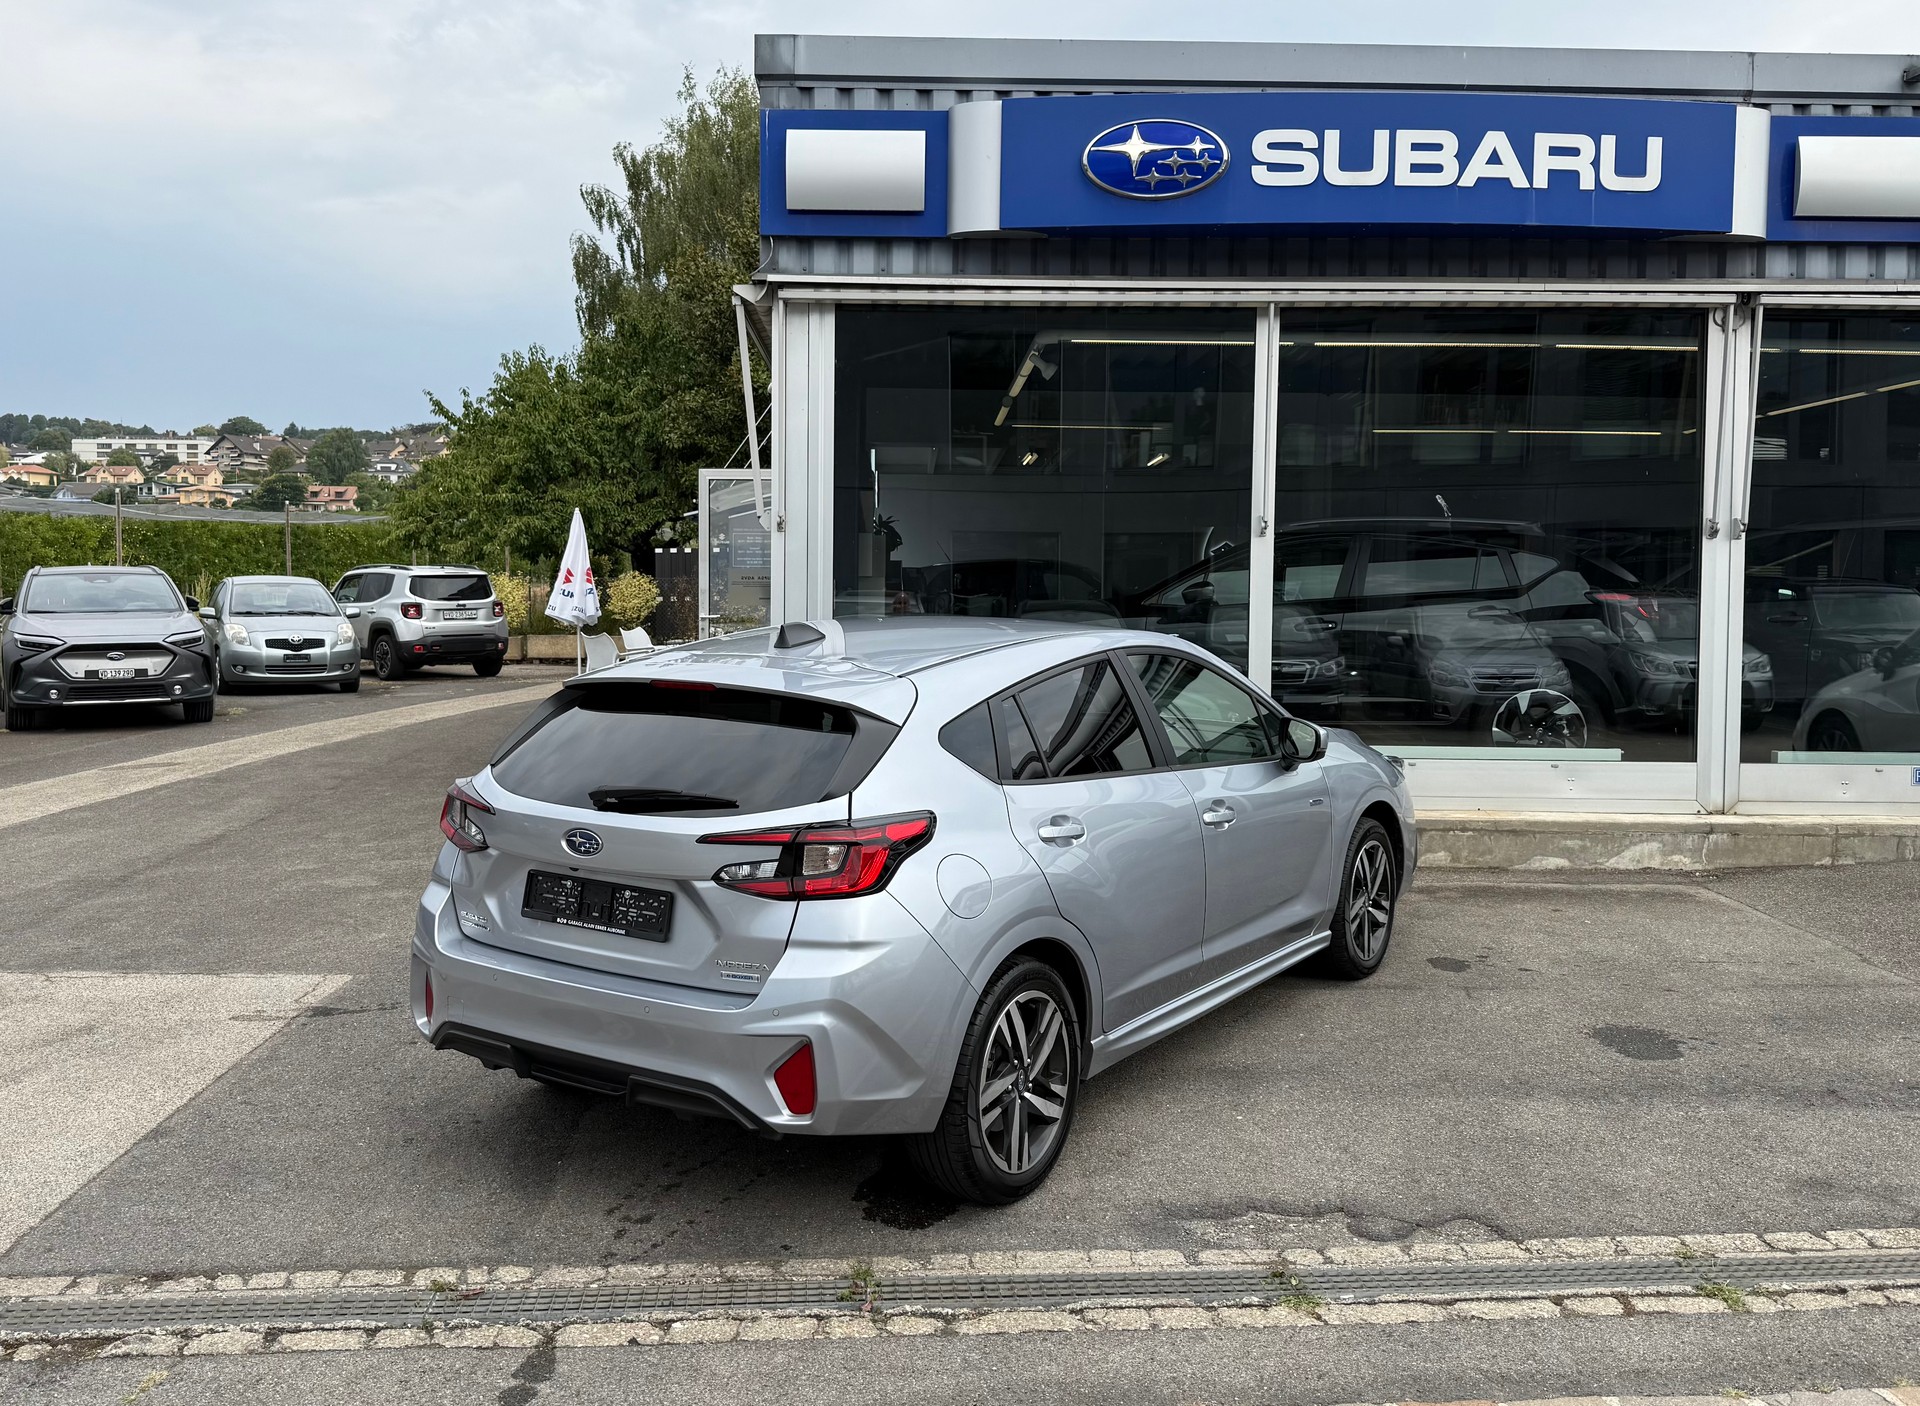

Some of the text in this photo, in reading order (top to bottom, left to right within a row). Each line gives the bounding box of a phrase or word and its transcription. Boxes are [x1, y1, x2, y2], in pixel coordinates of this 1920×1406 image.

[1251, 128, 1663, 192] SUBARU
[607, 927, 626, 935] AUBONNE
[715, 959, 770, 971] IMPREZA
